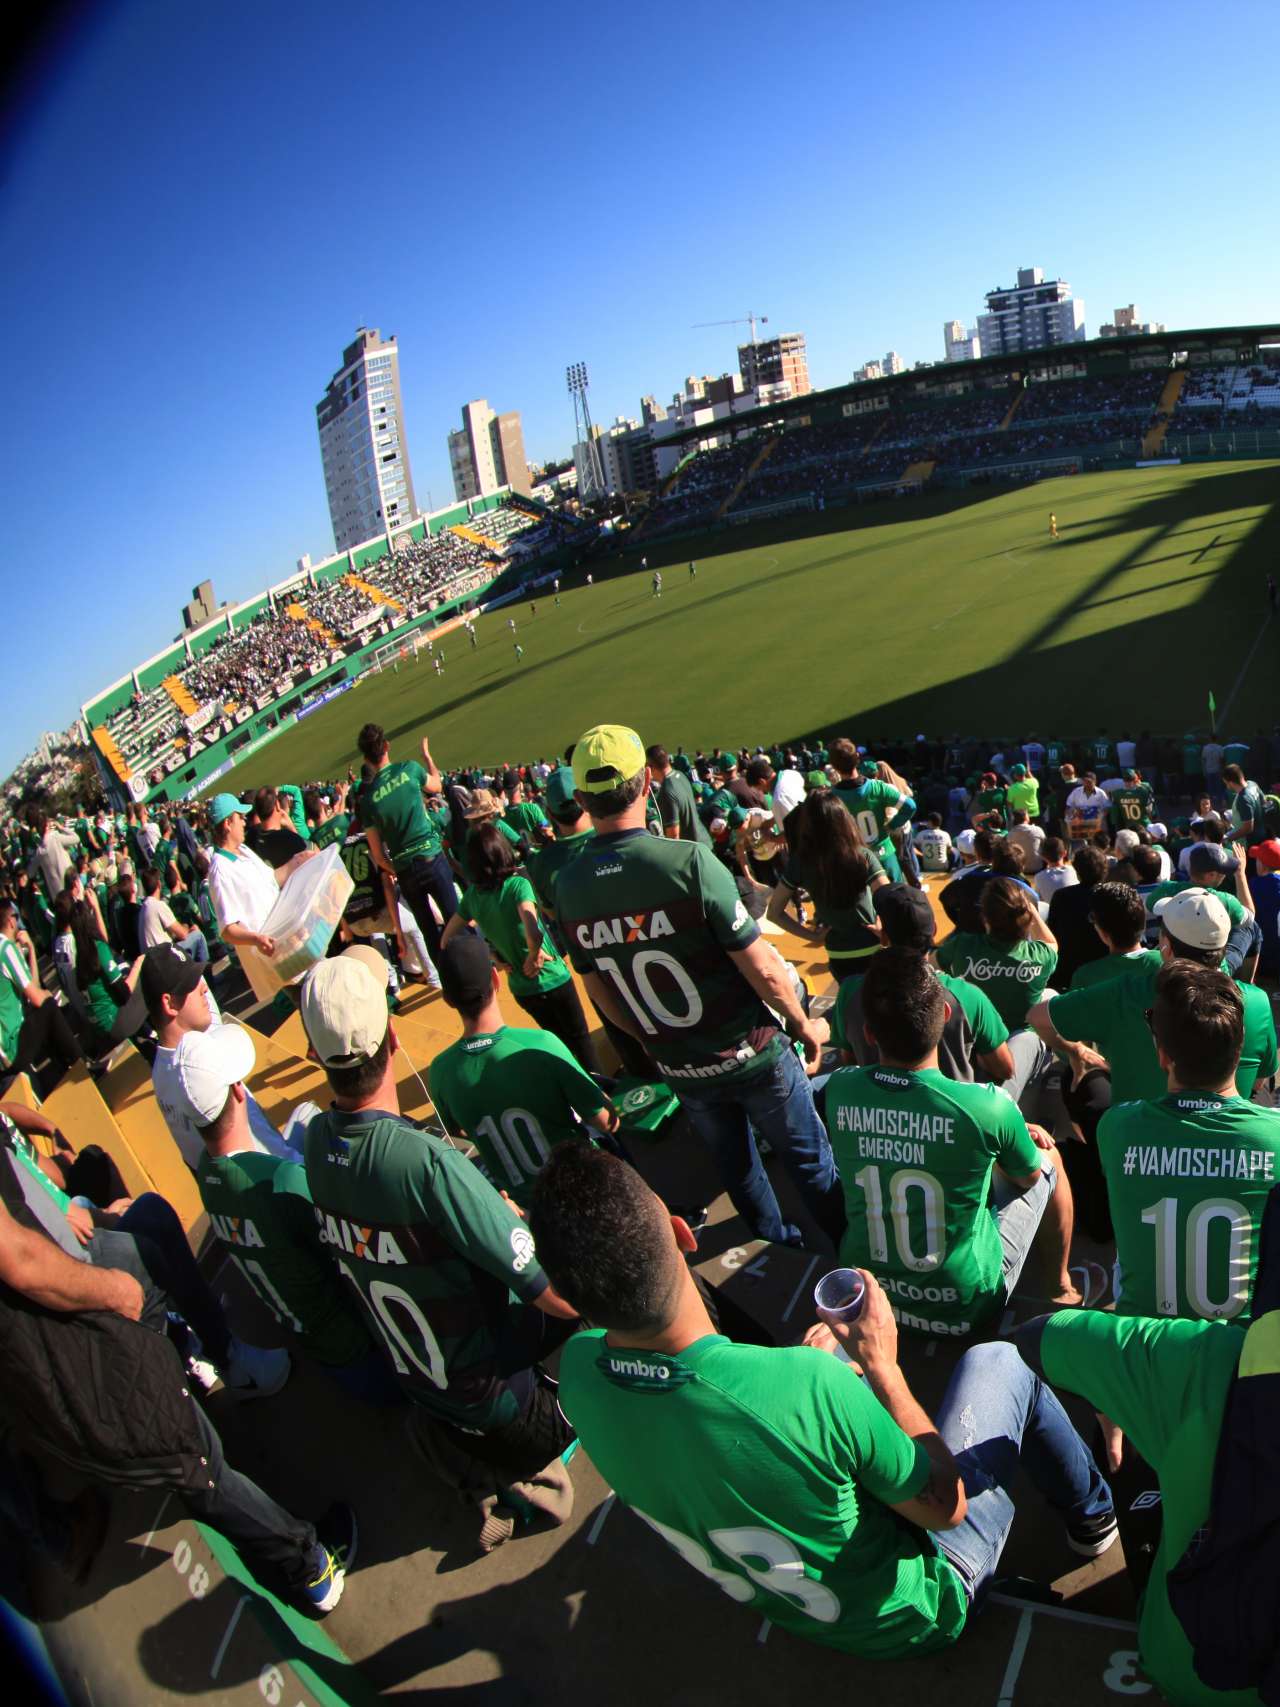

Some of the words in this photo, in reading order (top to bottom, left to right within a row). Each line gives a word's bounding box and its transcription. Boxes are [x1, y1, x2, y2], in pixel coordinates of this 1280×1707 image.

[372, 772, 410, 803] CAIXA
[1121, 804, 1141, 820] 10
[576, 910, 676, 950] CAIXA
[594, 950, 703, 1036] 10
[466, 1038, 493, 1050] umbro
[656, 1039, 758, 1080] Unimed
[874, 1071, 909, 1087] umbro
[1177, 1098, 1223, 1111] umbro
[837, 1105, 955, 1145] #VAMOSCHAPE
[476, 1107, 551, 1188] 10
[858, 1136, 926, 1166] EMERSON
[1123, 1146, 1276, 1181] #VAMOSCHAPE
[854, 1165, 946, 1273] 10
[1141, 1197, 1253, 1321] 10
[876, 1276, 959, 1303] SICOOB
[338, 1257, 449, 1391] 10
[609, 1356, 670, 1381] umbro
